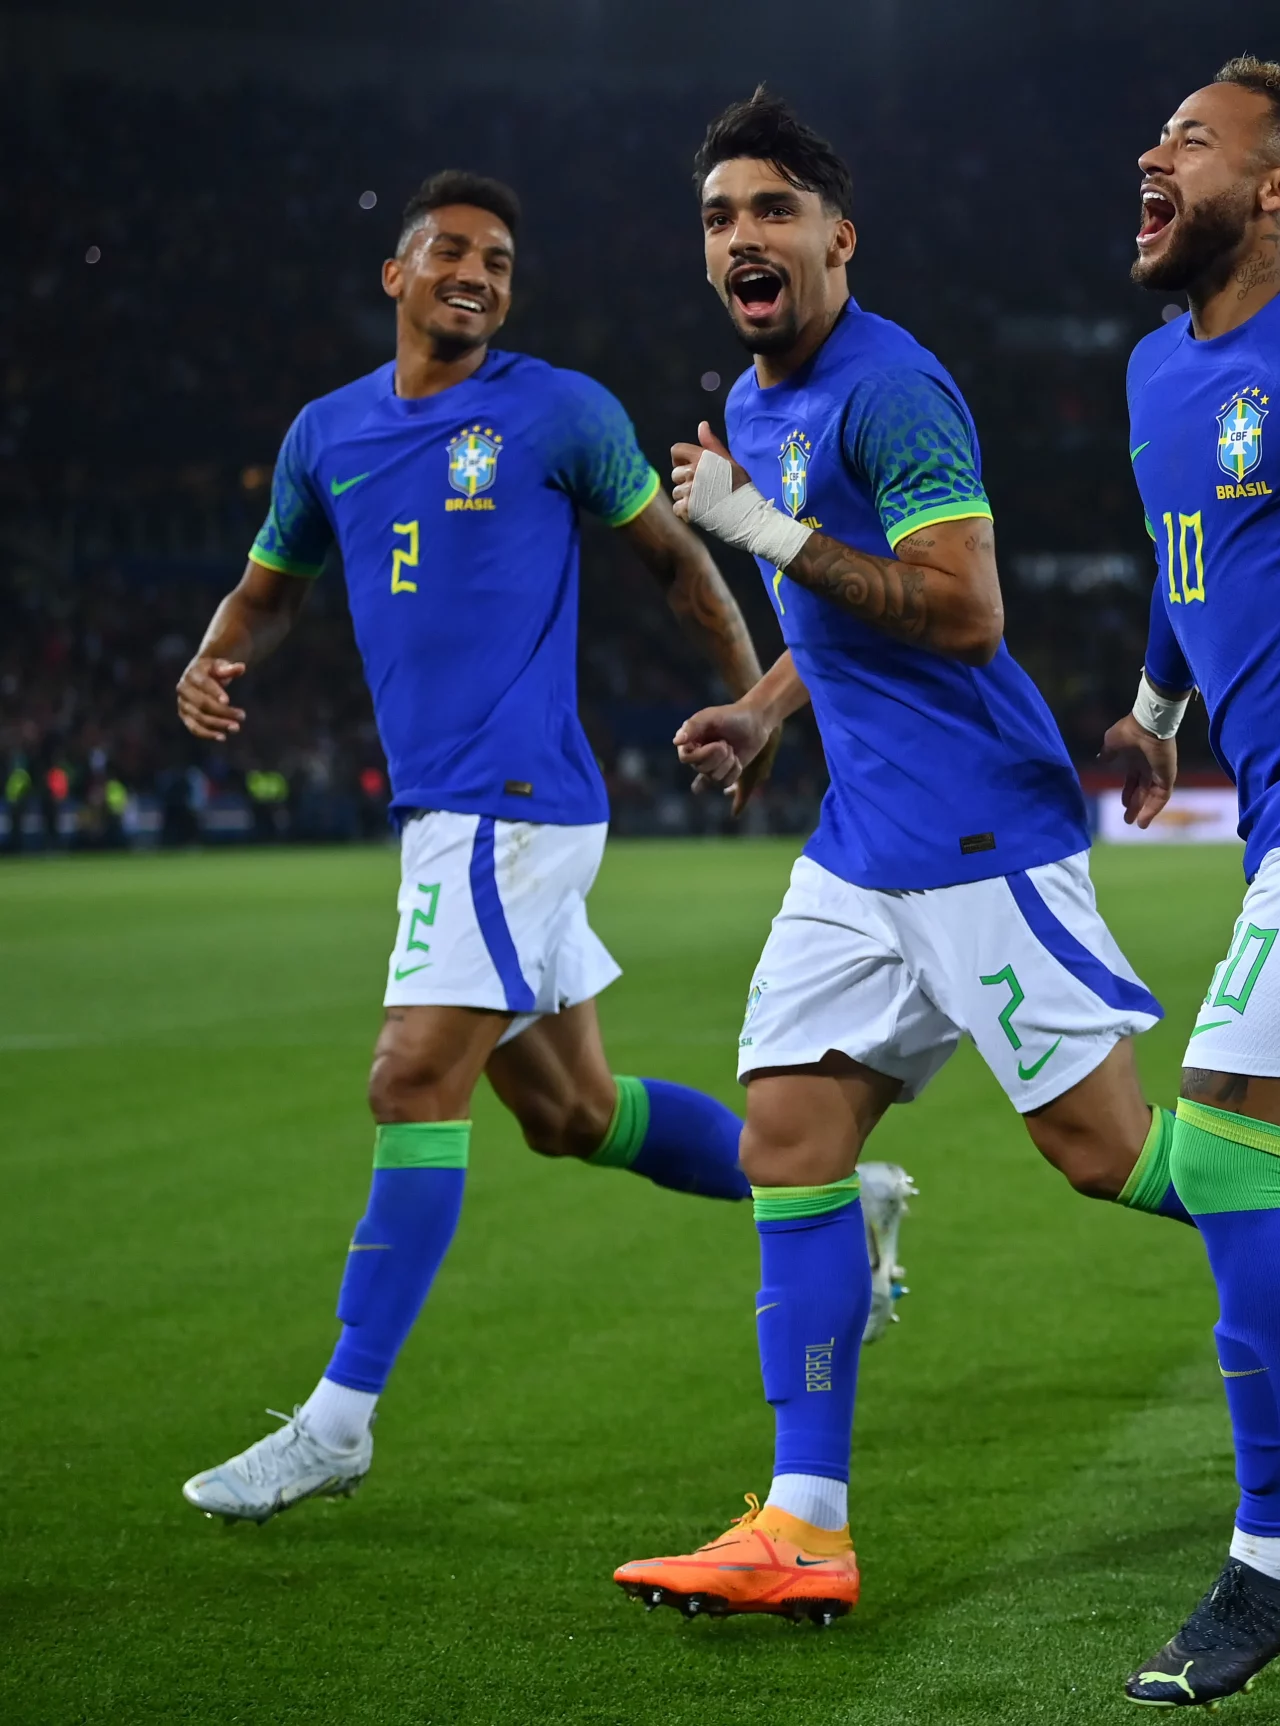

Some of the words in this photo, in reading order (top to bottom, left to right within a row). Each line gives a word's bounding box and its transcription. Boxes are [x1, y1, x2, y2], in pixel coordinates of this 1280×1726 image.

[1230, 431, 1248, 442] CBF
[789, 472, 800, 482] CBF
[1216, 481, 1272, 500] BRASIL
[445, 498, 497, 512] BRASIL
[800, 516, 823, 529] SIL
[391, 520, 419, 595] 2
[1162, 510, 1205, 605] 10
[407, 882, 441, 953] 2
[979, 963, 1025, 1051] 7
[740, 1037, 753, 1047] SIL
[805, 1337, 835, 1392] BRASIL
